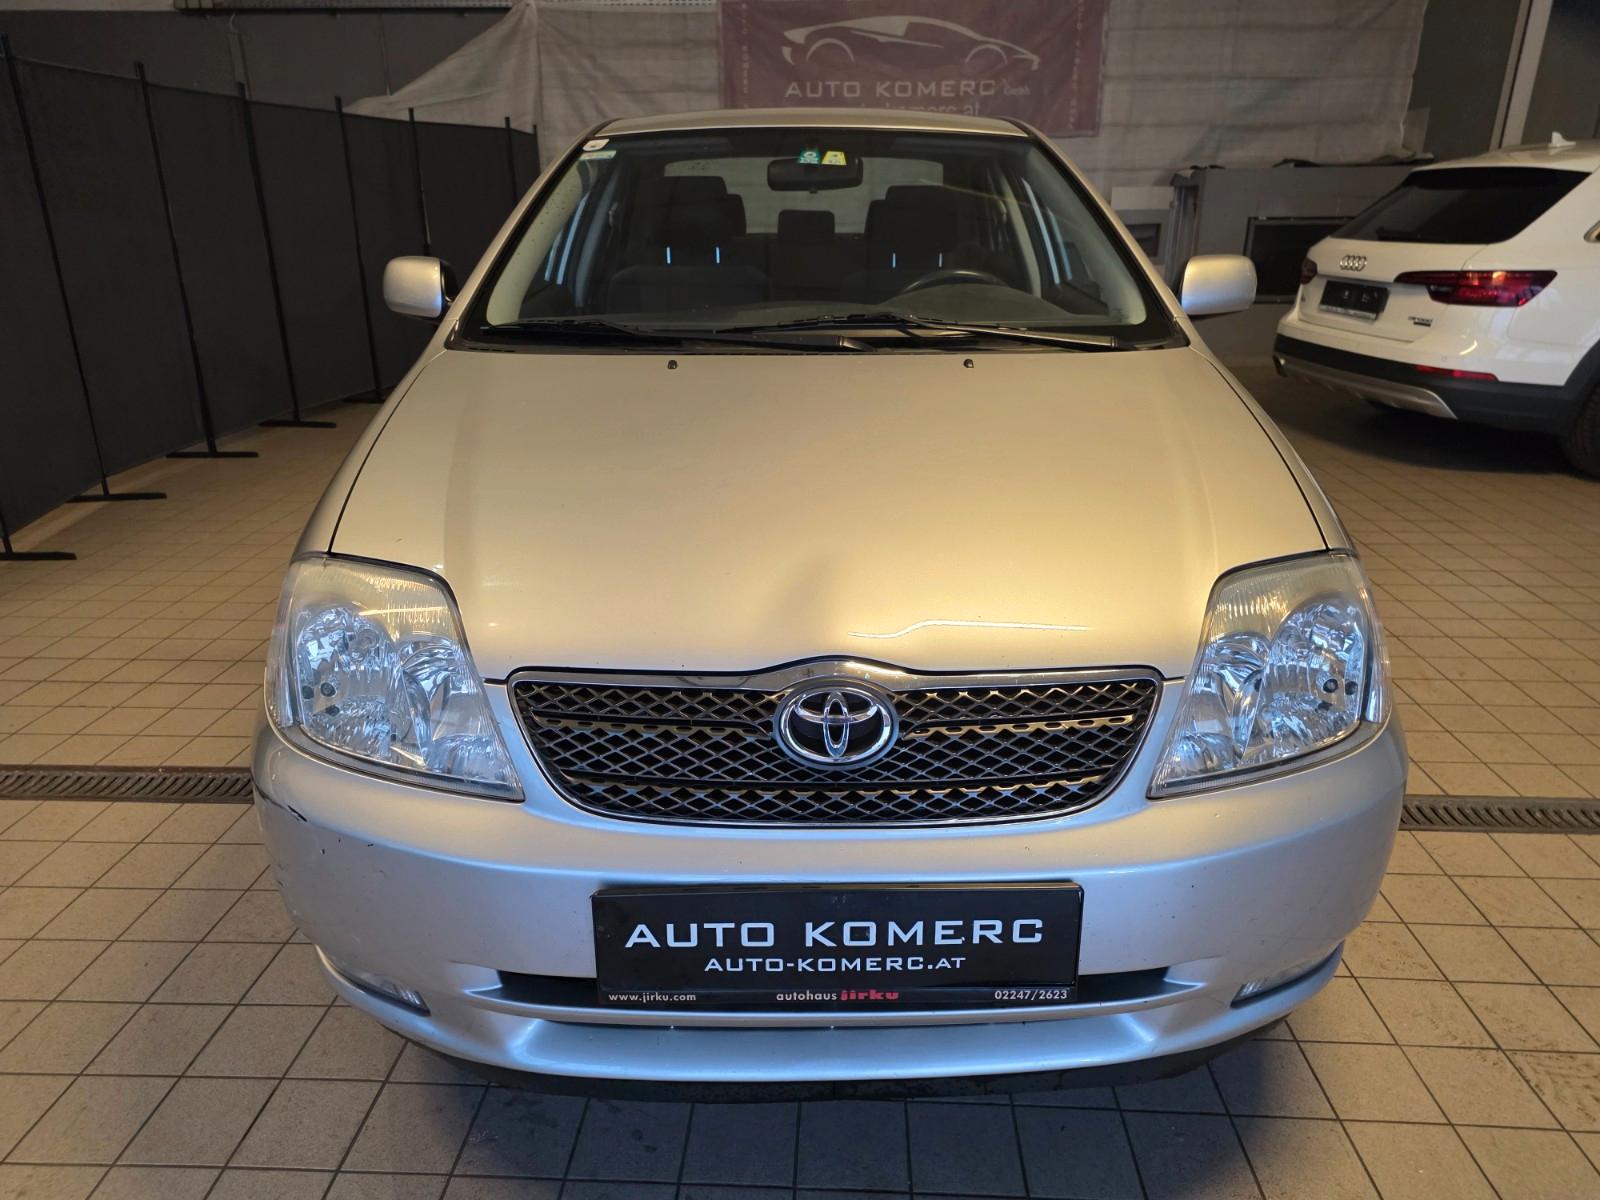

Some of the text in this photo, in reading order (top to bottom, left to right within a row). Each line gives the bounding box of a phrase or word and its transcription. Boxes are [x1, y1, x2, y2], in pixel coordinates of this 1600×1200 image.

[784, 81, 861, 98] AUTO
[876, 80, 996, 98] KOMERC
[625, 919, 1044, 947] AUTO KOMERC
[704, 957, 966, 971] AUTO-KOMERC.AT
[608, 991, 696, 1003] www.jirku.com
[776, 990, 837, 1001] autohaus
[994, 989, 1067, 1001] 02247/2623
